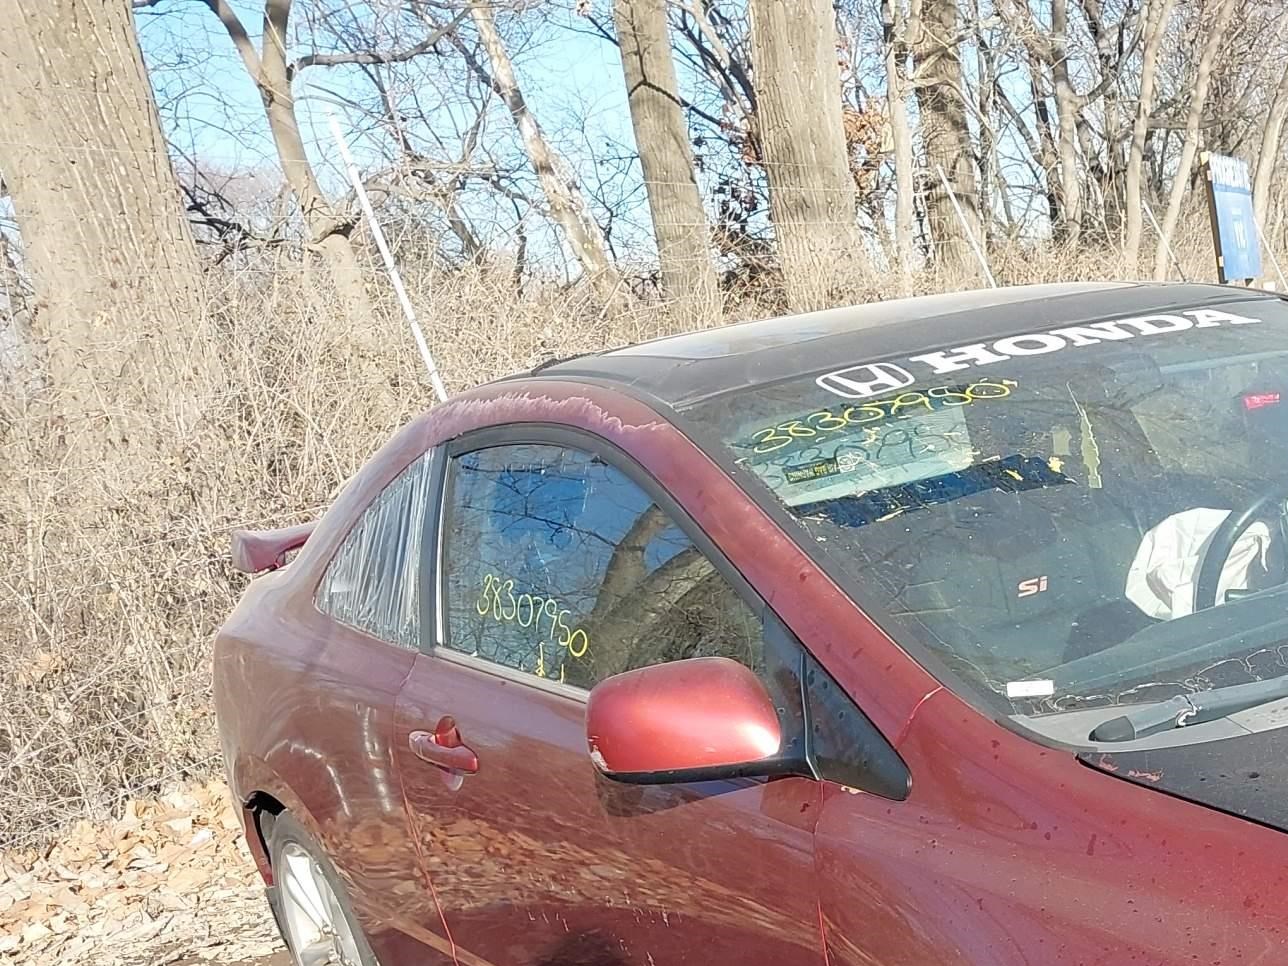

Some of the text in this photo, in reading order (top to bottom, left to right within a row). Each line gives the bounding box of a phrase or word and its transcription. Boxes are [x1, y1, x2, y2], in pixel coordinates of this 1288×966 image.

[909, 309, 1262, 374] HONDA
[476, 573, 588, 657] 38307950
[1017, 575, 1048, 598] Si
